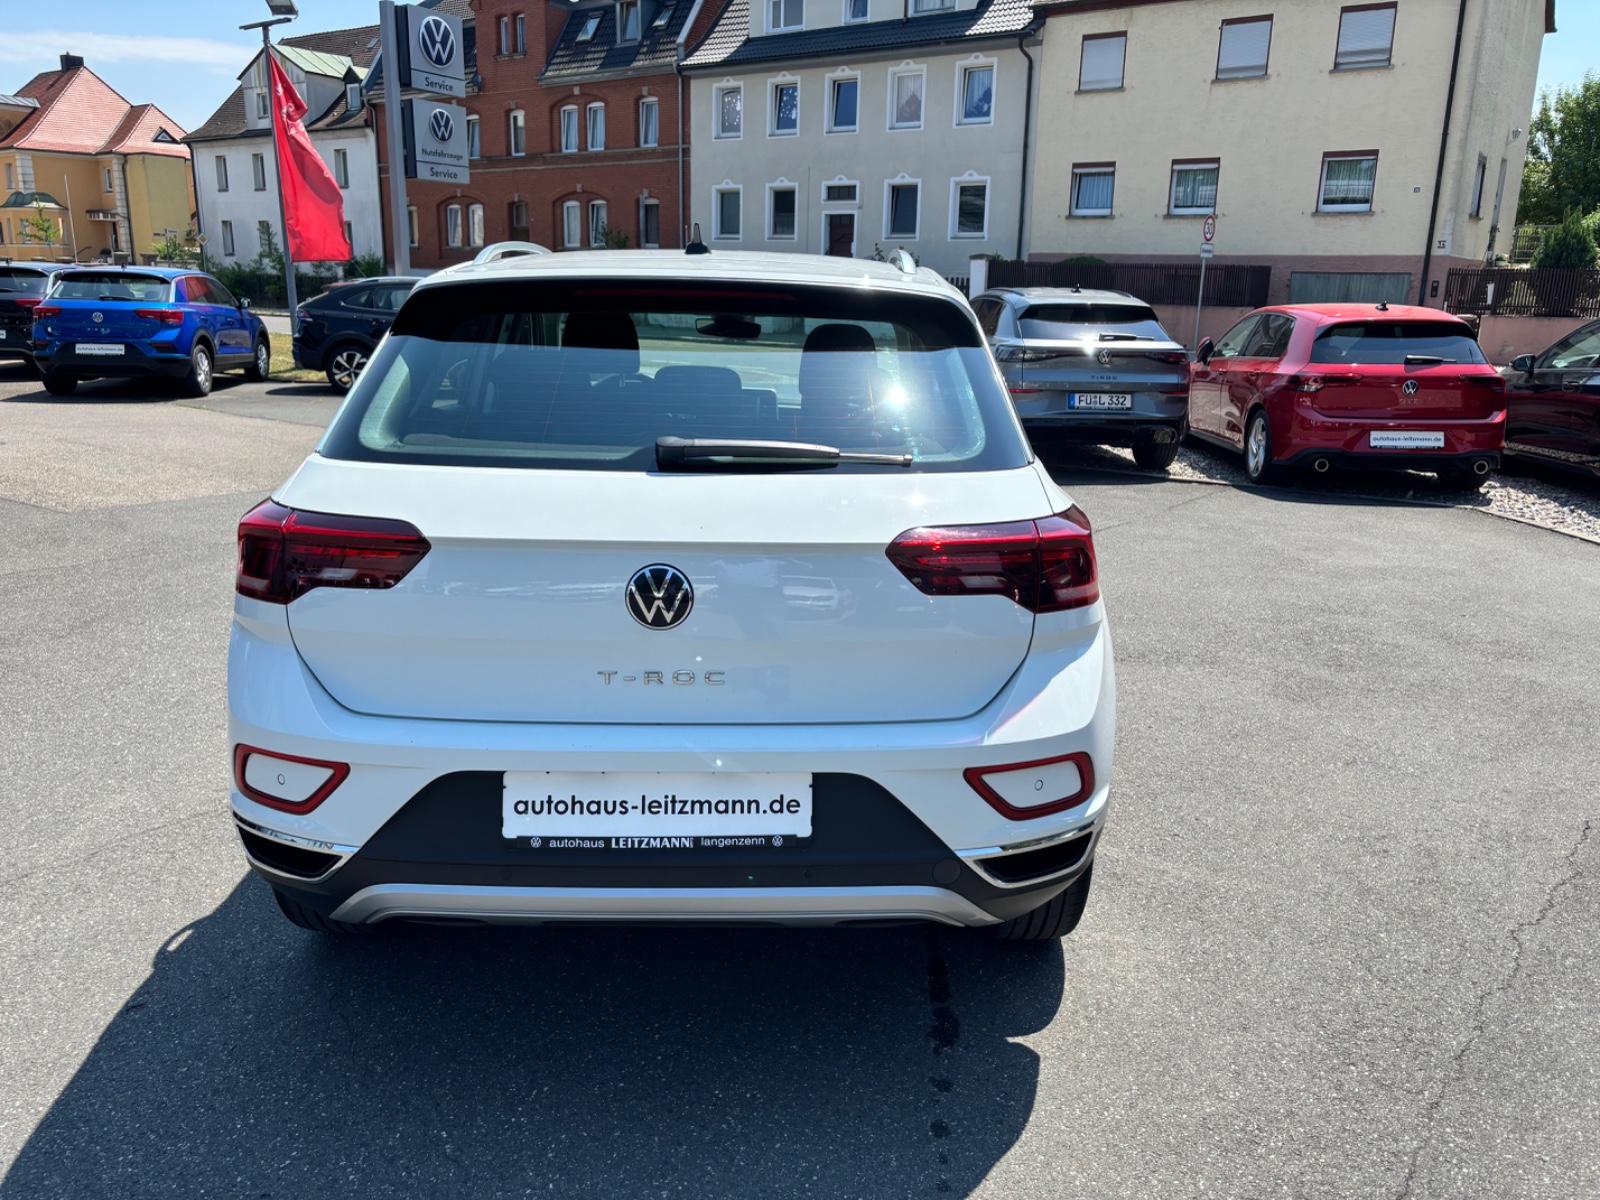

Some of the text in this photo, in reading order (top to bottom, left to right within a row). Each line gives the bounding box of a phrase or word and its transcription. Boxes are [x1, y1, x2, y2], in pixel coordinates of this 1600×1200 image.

[425, 76, 454, 92] Service
[430, 167, 458, 179] Service
[1108, 395, 1127, 406] 332
[597, 670, 726, 686] T-ROC
[513, 794, 802, 816] autohaus-leitzmann.de
[549, 838, 605, 848] autohaus
[611, 836, 690, 849] LEITZMANN
[701, 836, 765, 848] langenzenn
